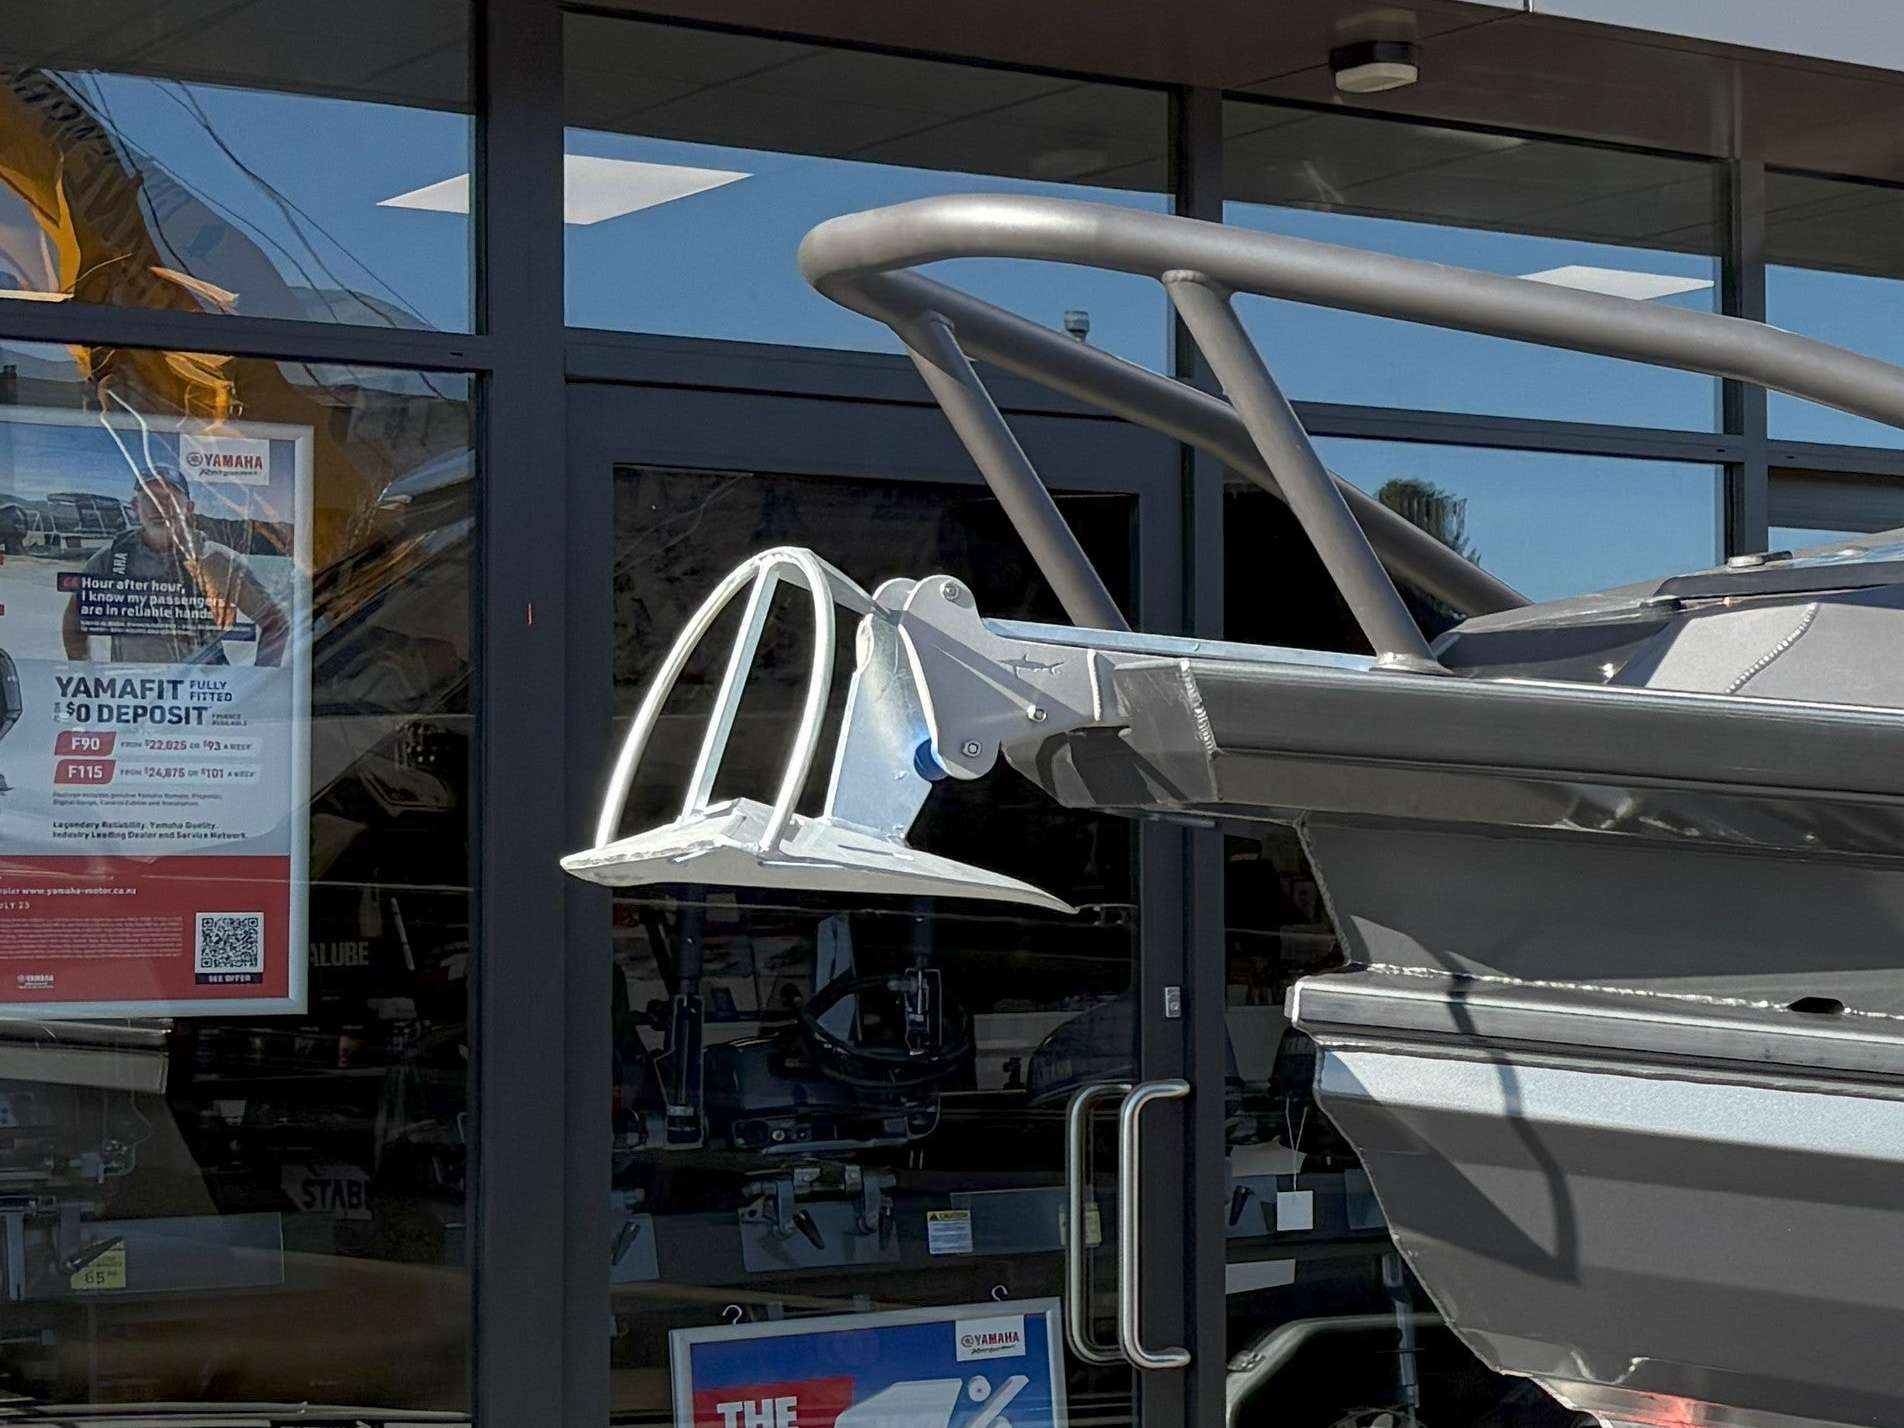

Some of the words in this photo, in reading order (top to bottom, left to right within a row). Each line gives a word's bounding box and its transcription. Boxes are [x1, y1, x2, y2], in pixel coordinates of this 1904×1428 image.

[205, 453, 264, 469] YAMAHA
[82, 578, 113, 590] Hour
[116, 578, 149, 591] after
[151, 580, 186, 594] hour,
[89, 591, 124, 603] know
[127, 594, 148, 608] my
[81, 606, 103, 616] are
[106, 605, 119, 615] in
[121, 605, 173, 618] reliable
[55, 676, 184, 700] YAMAFIT
[190, 680, 227, 690] FULLY
[190, 691, 233, 702] FITTED
[66, 701, 91, 723] $0
[97, 704, 208, 726] DEPOSIT
[71, 737, 100, 750] F90
[68, 765, 103, 778] F115
[974, 1331, 1020, 1346] YAMAHA
